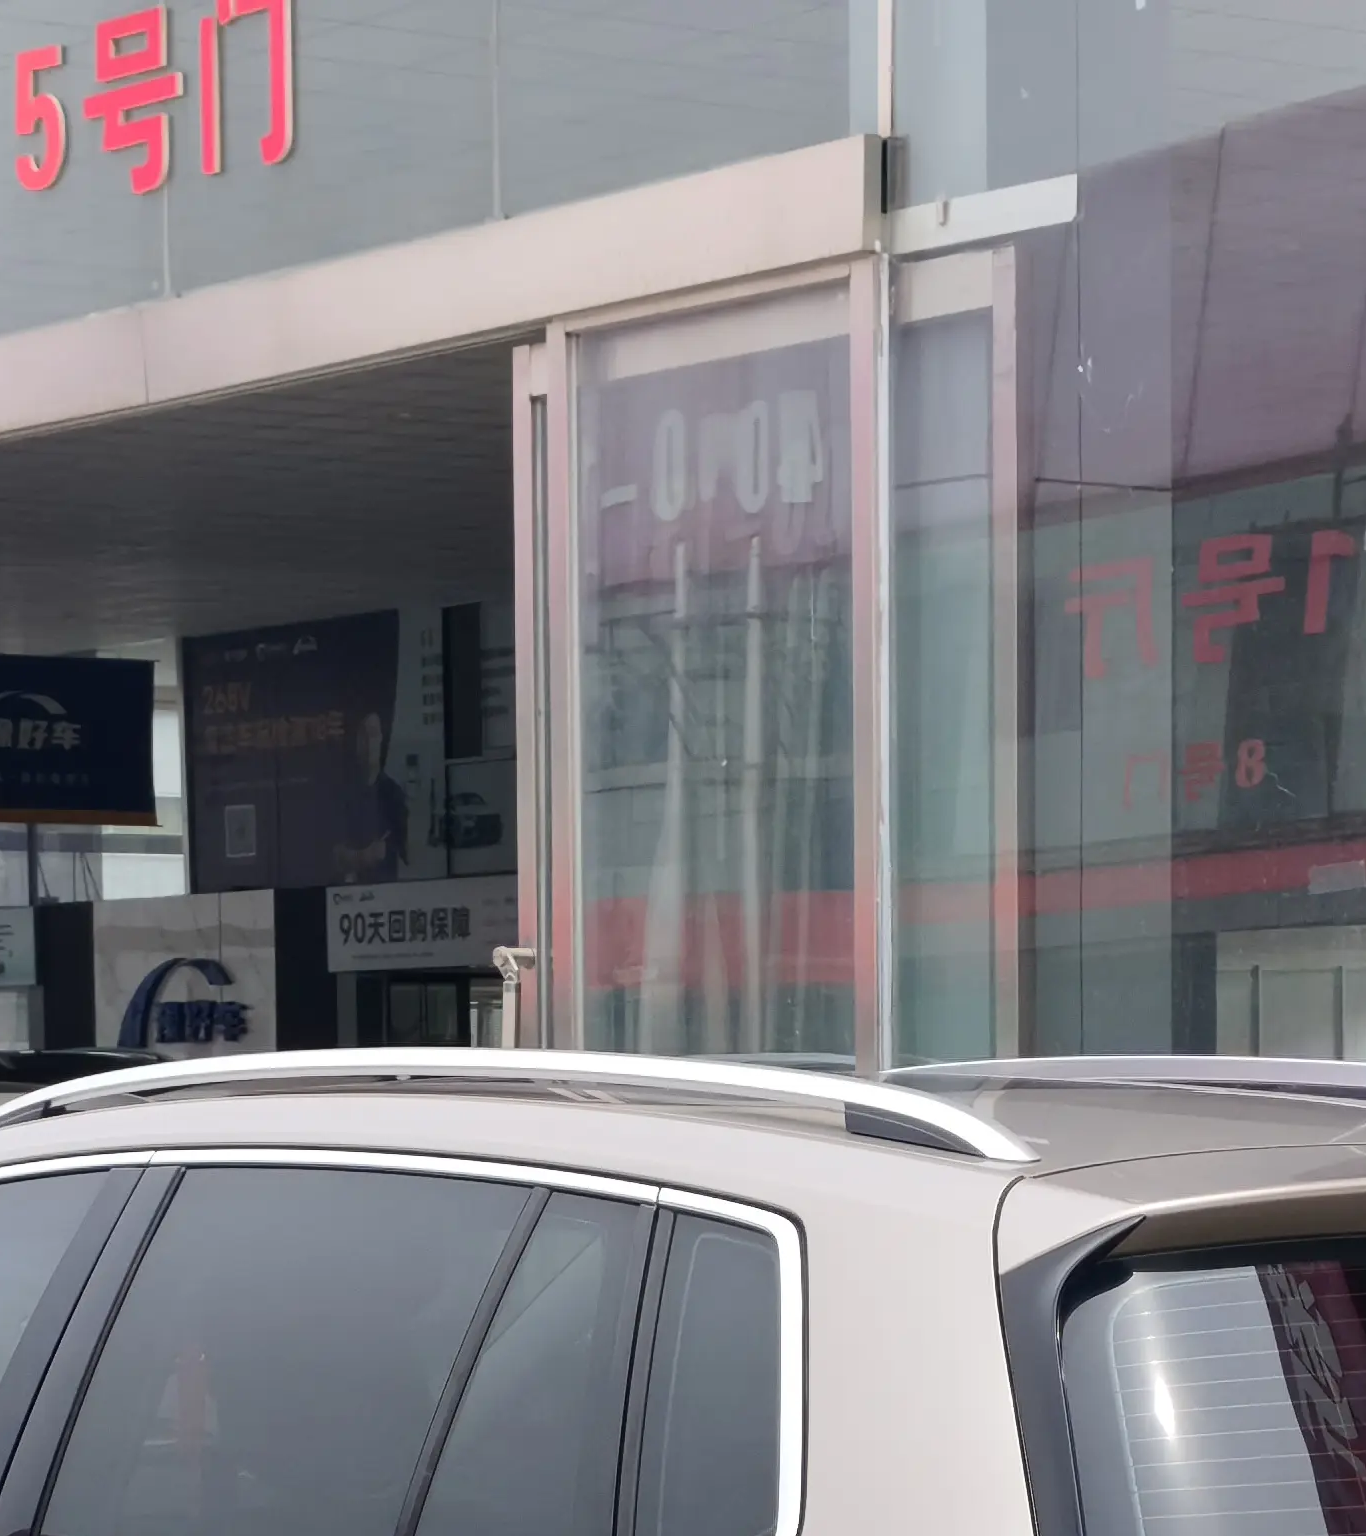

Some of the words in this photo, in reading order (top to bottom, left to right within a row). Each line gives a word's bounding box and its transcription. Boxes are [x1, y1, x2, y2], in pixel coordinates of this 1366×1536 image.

[15, 0, 295, 195] 5号门
[338, 905, 472, 945] 90天回购保障
